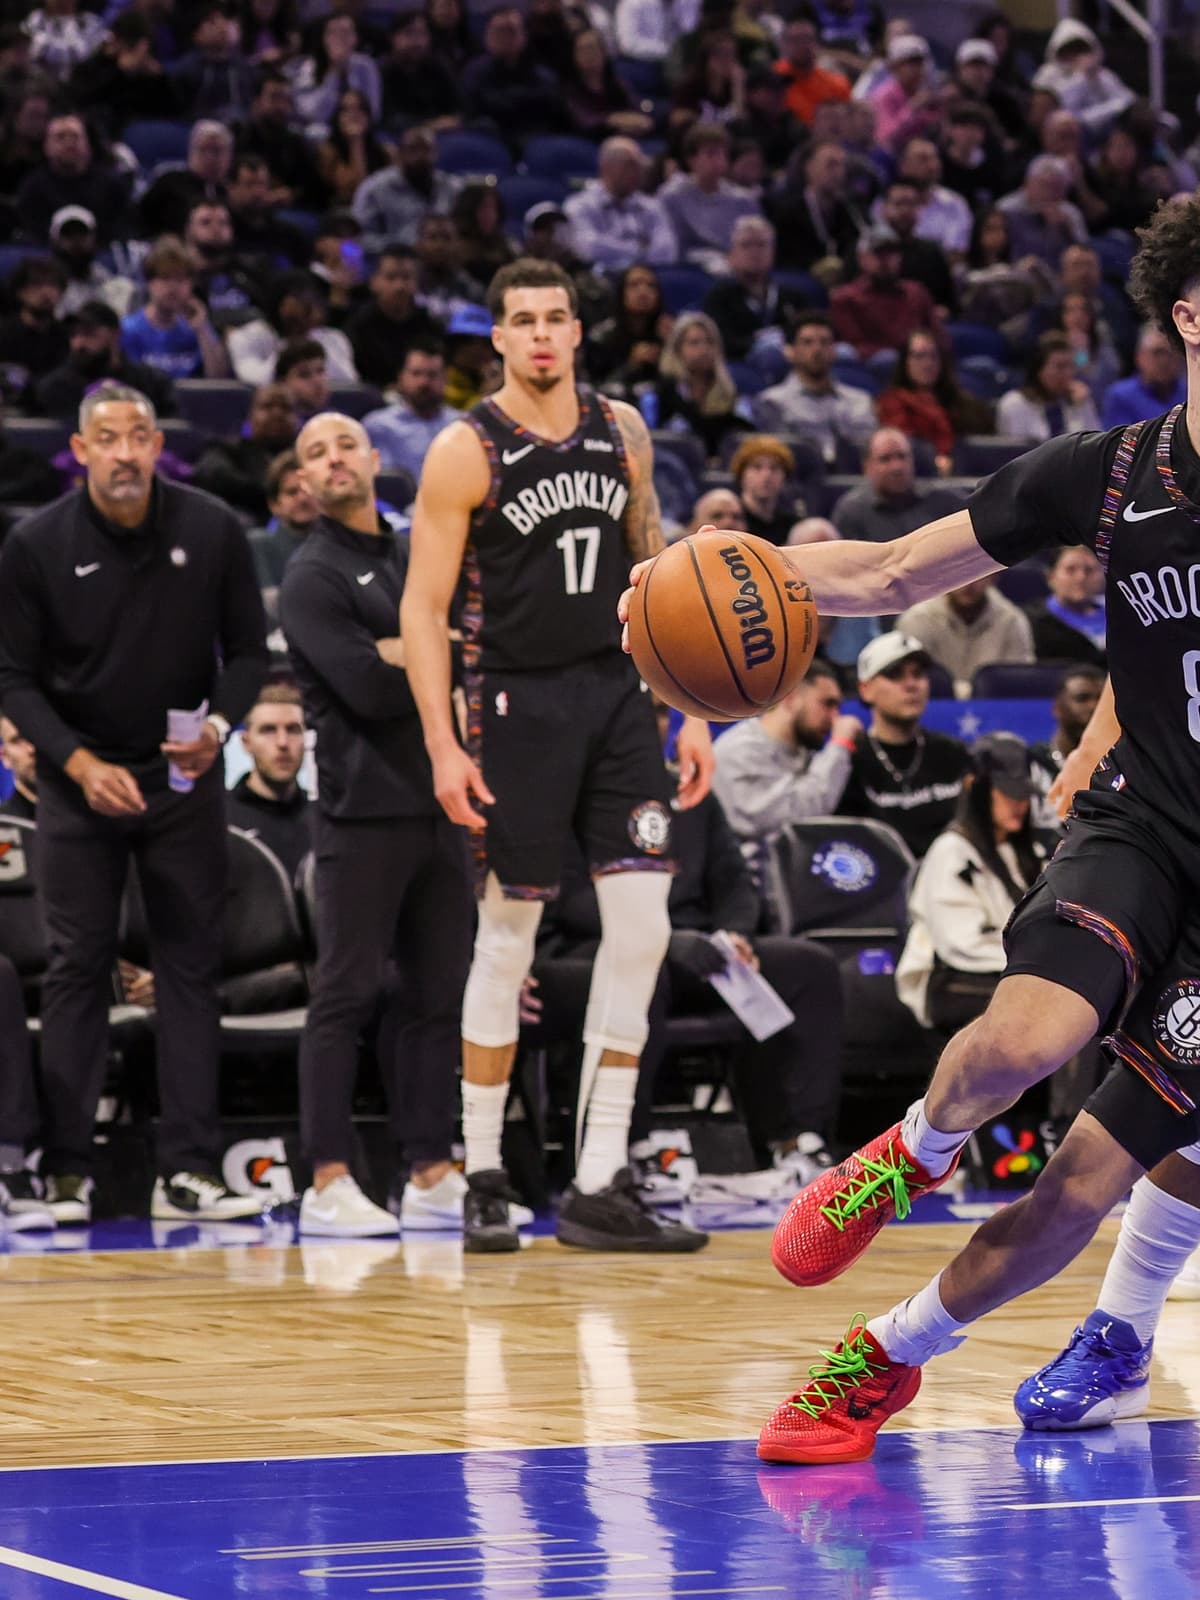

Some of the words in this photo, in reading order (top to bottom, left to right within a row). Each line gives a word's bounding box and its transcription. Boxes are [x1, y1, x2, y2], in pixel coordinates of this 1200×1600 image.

[501, 471, 629, 536] BROOKLYN
[556, 526, 601, 595] 17
[719, 545, 775, 670] Wilson
[1158, 1014, 1169, 1041] NEW
[222, 1136, 294, 1203] G
